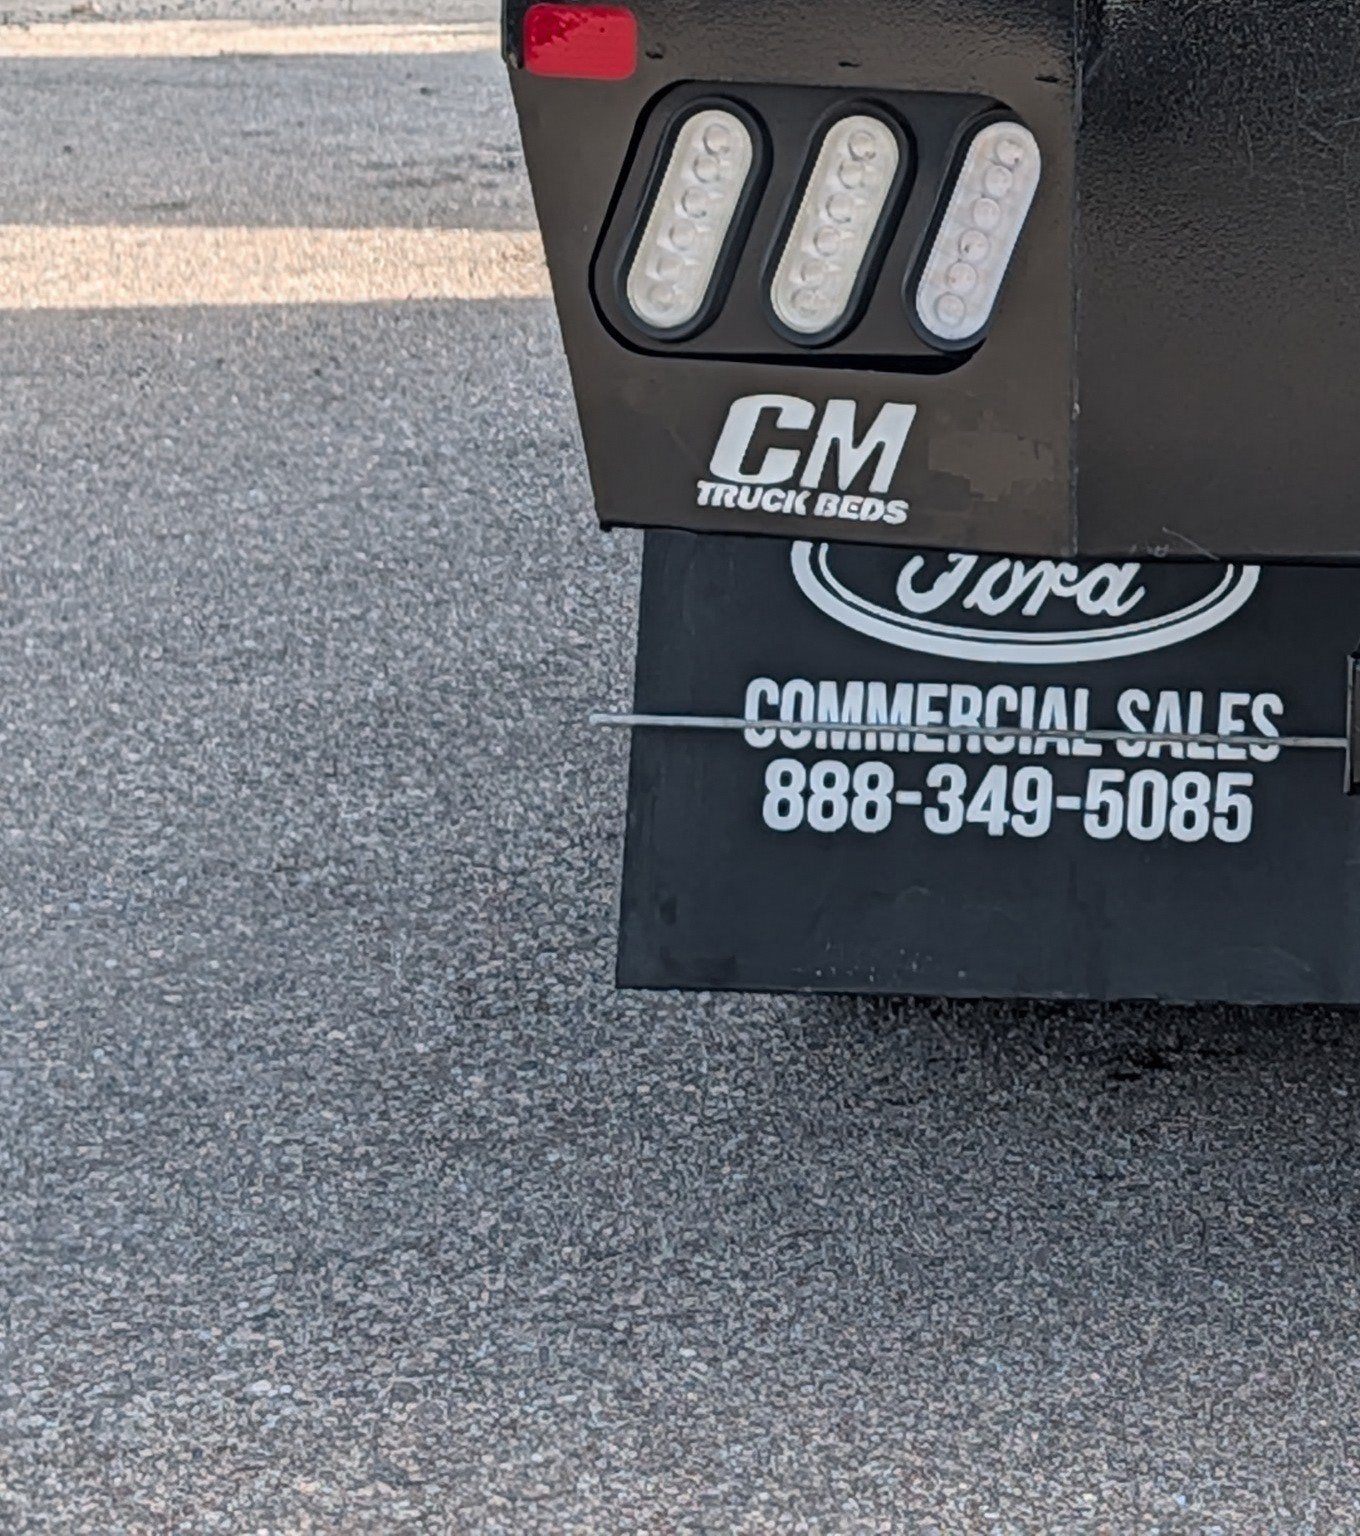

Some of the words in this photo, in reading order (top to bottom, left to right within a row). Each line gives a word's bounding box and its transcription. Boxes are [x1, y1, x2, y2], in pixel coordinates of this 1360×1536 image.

[708, 393, 918, 494] CM
[697, 479, 808, 517] TRUCK
[813, 491, 909, 525] BEDS
[744, 676, 1102, 757] COMMERCIAL
[1116, 688, 1284, 762] SALES
[762, 759, 1255, 844] 888-349-5085
